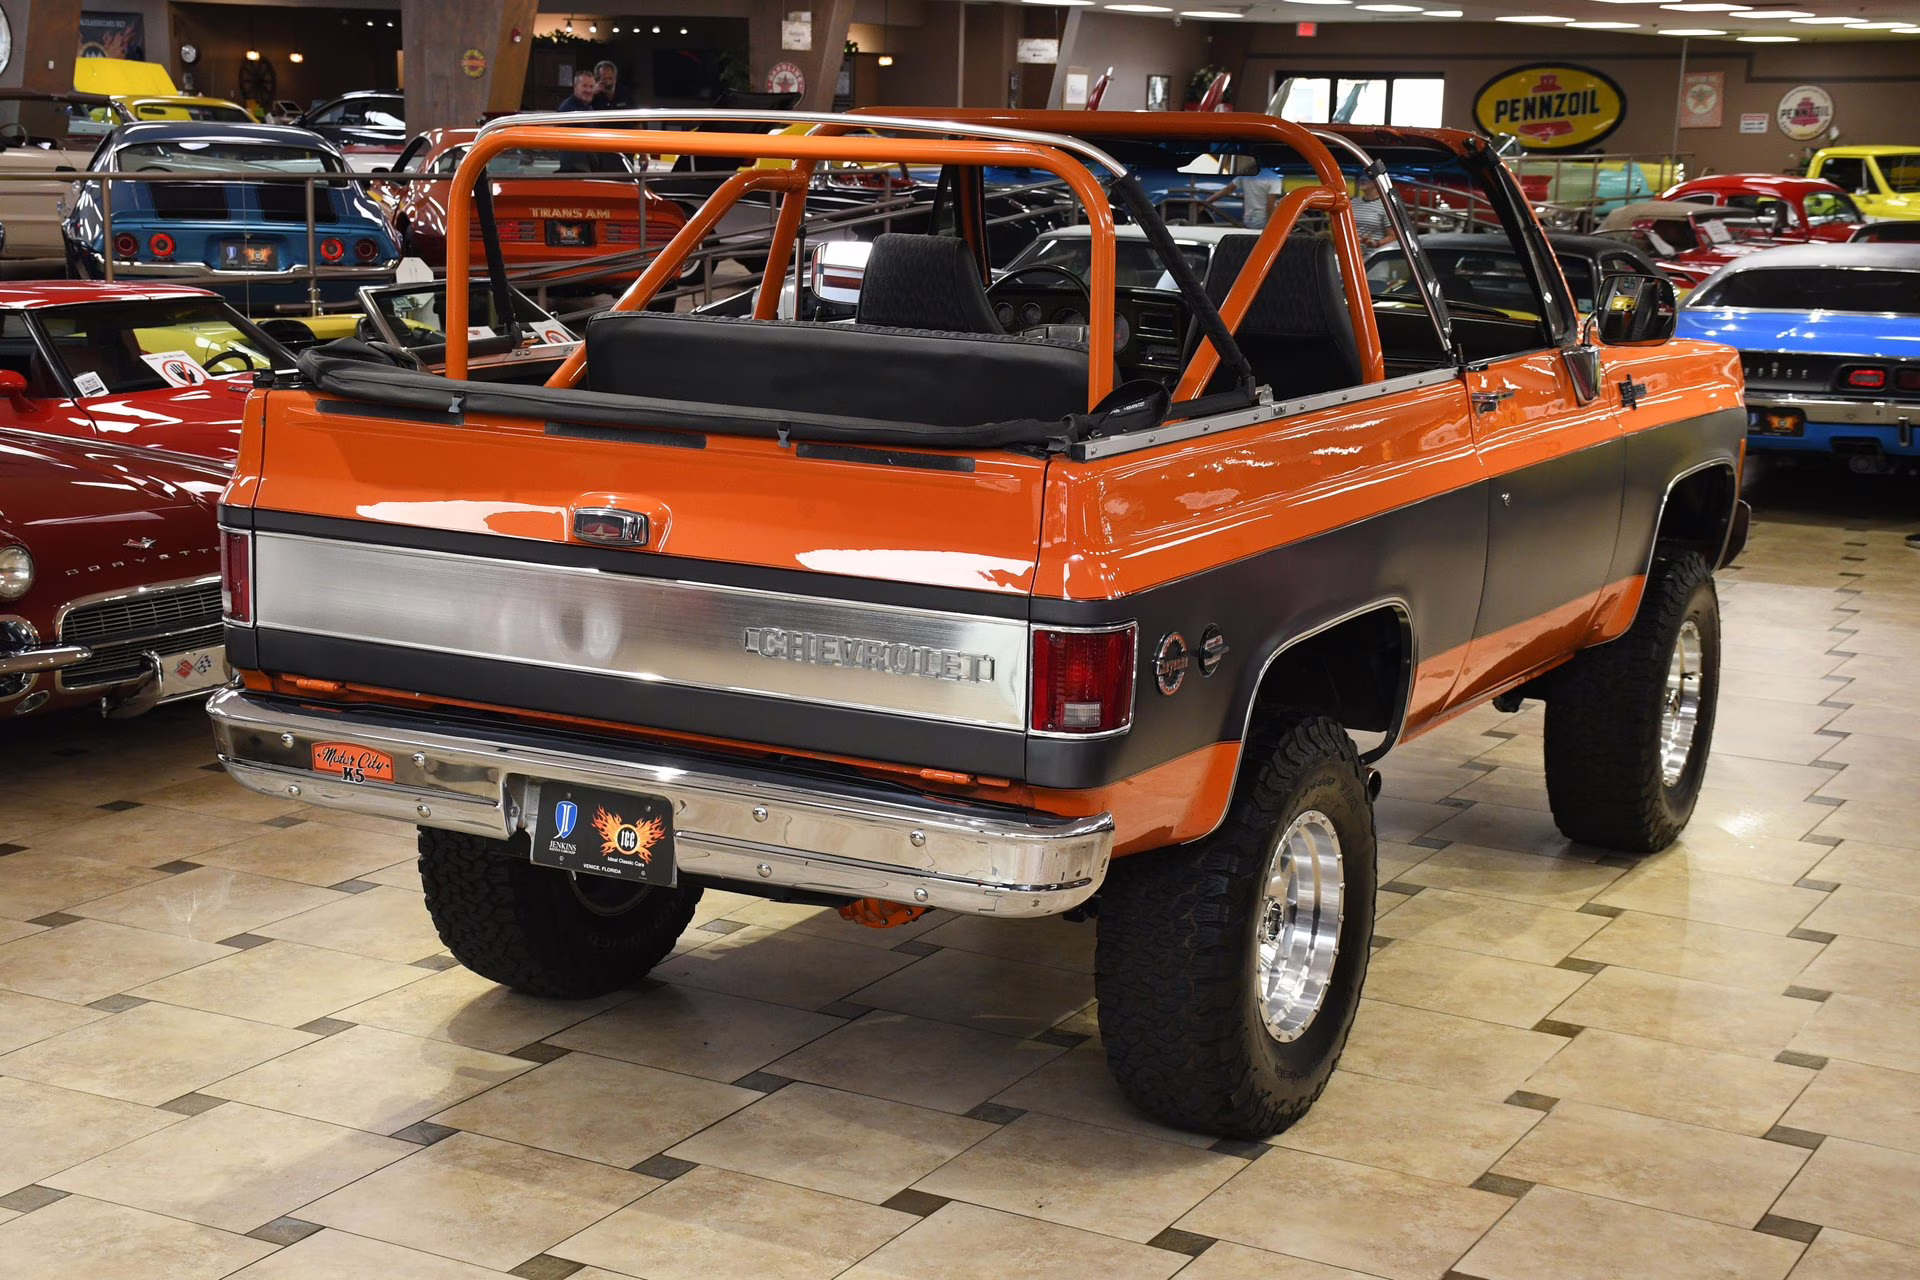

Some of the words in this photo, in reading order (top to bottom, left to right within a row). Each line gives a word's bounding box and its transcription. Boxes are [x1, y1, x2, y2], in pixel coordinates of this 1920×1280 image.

[768, 63, 802, 82] GASOLINE
[1494, 90, 1600, 124] PENNZOIL
[1781, 105, 1830, 119] PENNZOIL
[530, 208, 583, 218] TRANS
[585, 208, 611, 219] AM
[755, 626, 985, 684] CHEVROLET
[321, 746, 355, 767] Motor
[357, 752, 385, 774] City
[341, 766, 366, 785] K5
[550, 841, 577, 852] JENKINS
[583, 863, 601, 871] VENICE,
[601, 866, 622, 874] FLORIDA
[618, 858, 634, 866] Classic
